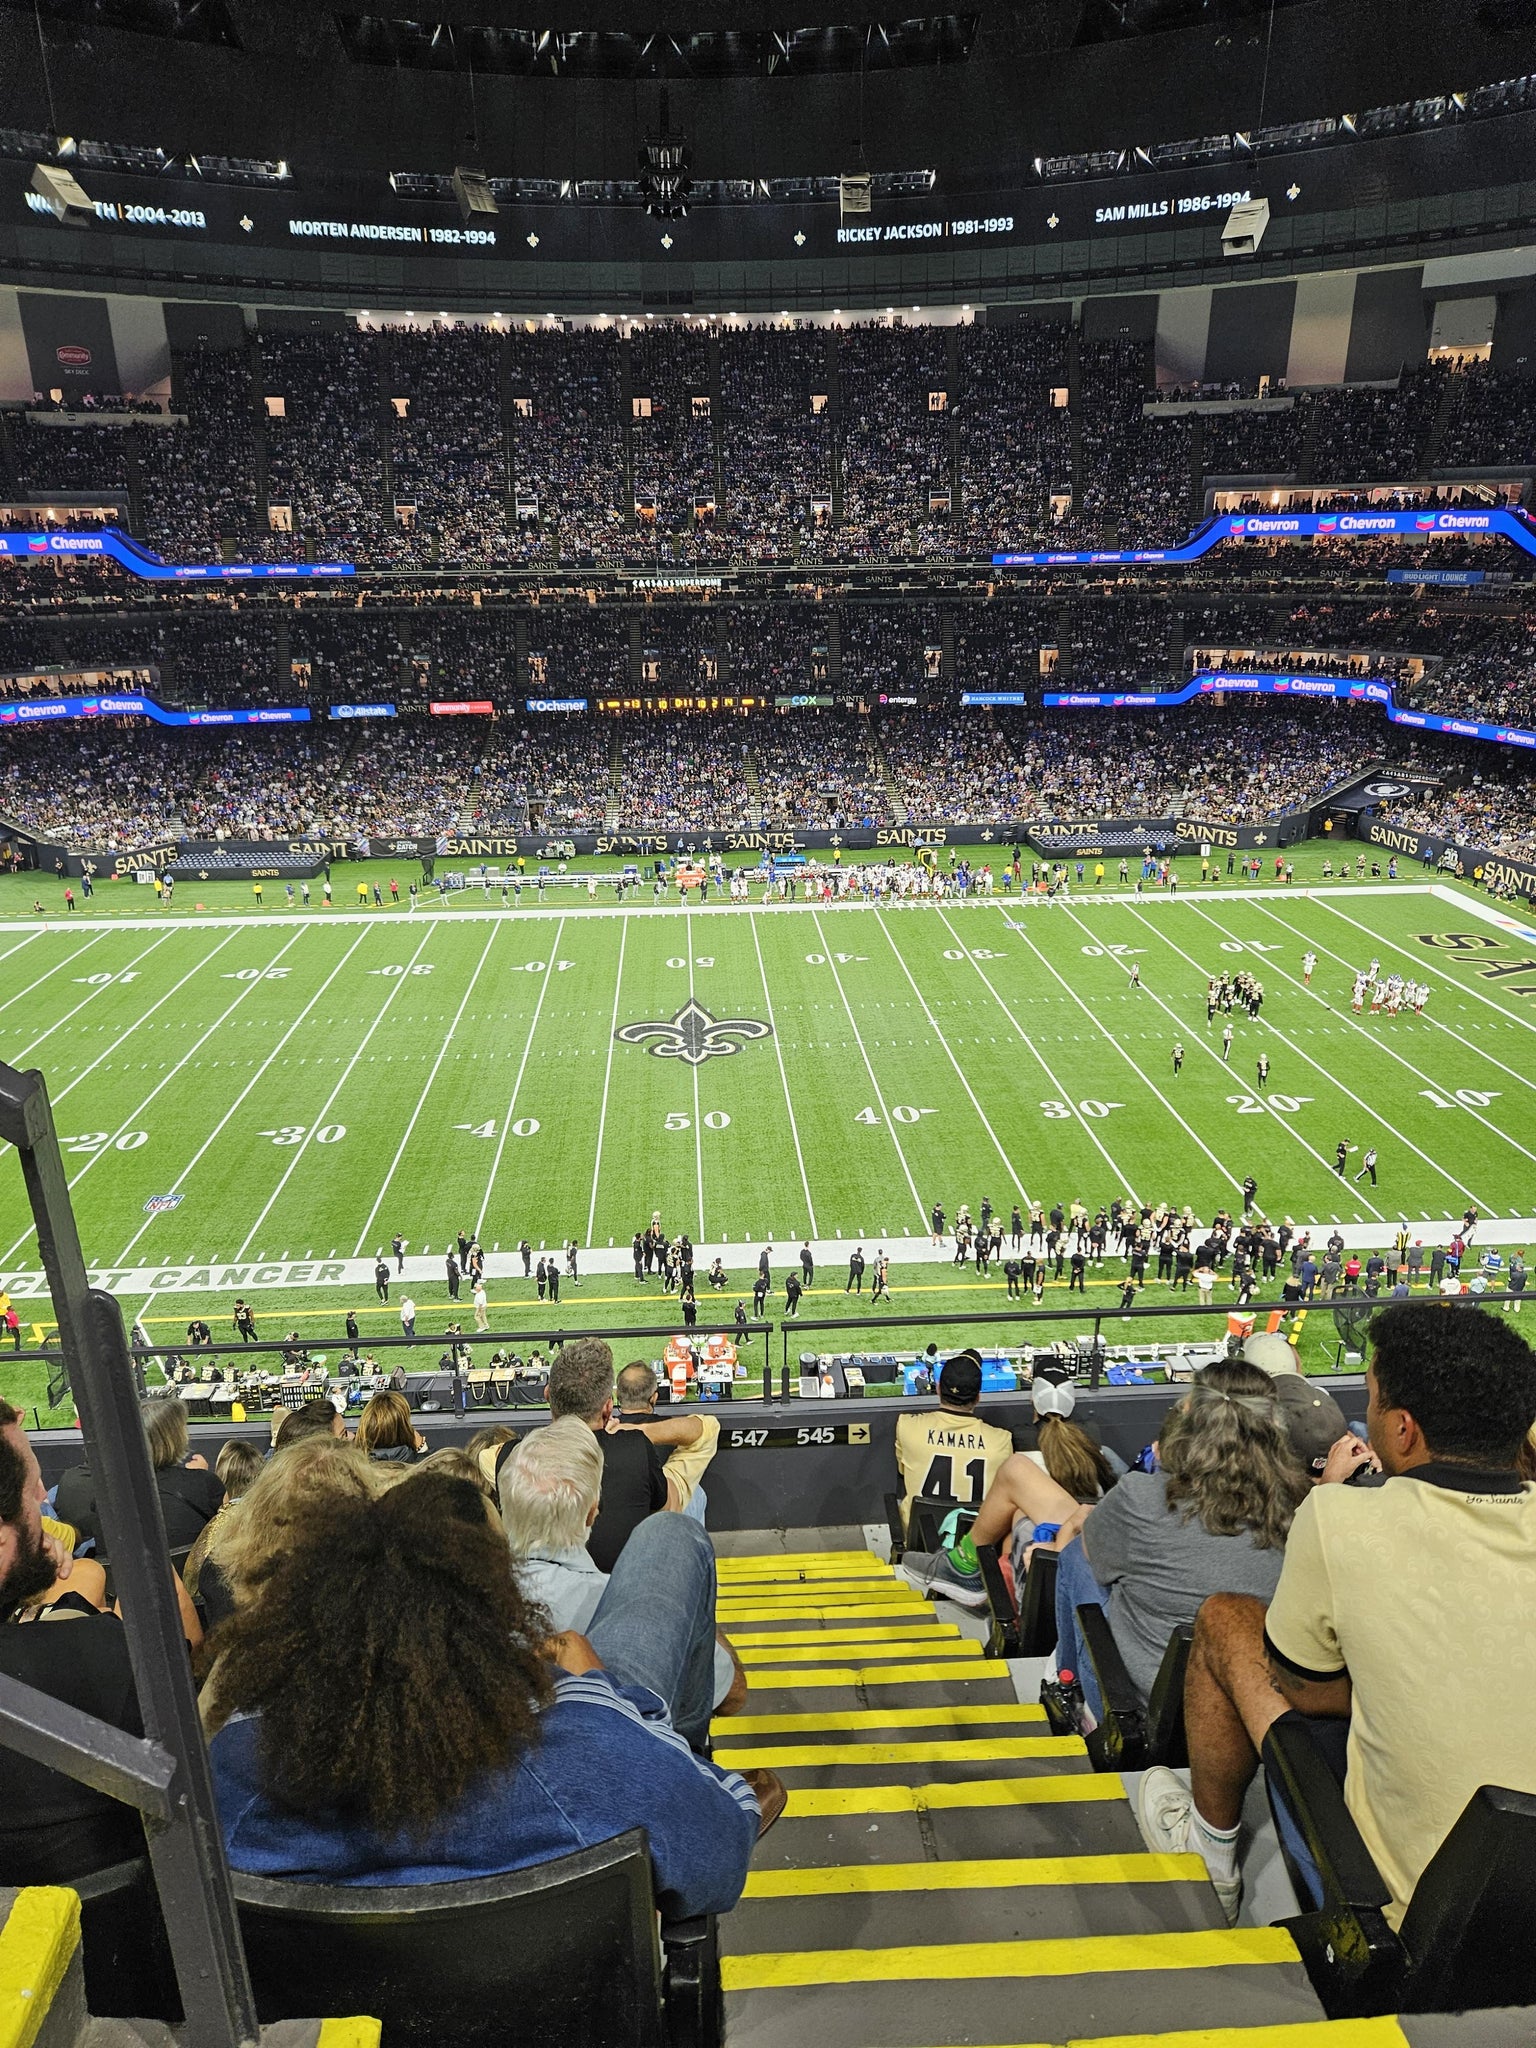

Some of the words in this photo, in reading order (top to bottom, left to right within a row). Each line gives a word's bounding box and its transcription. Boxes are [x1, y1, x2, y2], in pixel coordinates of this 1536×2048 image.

[1095, 205, 1125, 223] SAM
[1128, 201, 1168, 219] MILLS
[1177, 190, 1252, 213] 1986-1994
[124, 204, 207, 229] 2004-2013
[289, 220, 348, 238] MORTEN
[350, 223, 422, 242] ANDERSEN
[428, 228, 497, 246] 1982-1994
[837, 226, 882, 243] RICKEY
[883, 222, 943, 241] JACKSON
[951, 216, 1014, 236] 1981-1993
[1247, 518, 1299, 531] Chevron
[1340, 516, 1396, 530] Chevron
[1439, 514, 1490, 528] Chevron
[51, 537, 103, 550] Chevron
[528, 561, 558, 570] SAINTS
[595, 560, 625, 569] SAINTS
[728, 558, 758, 567] SAINTS
[793, 557, 823, 565] SAINTS
[859, 556, 889, 564] SAINTS
[925, 555, 955, 563] SAINTS
[391, 563, 422, 571] SAINTS
[461, 562, 491, 571] SAINTS
[675, 578, 722, 587] SUPERDOME
[1441, 573, 1467, 582] LOUNGE
[1215, 677, 1259, 690] Chevron
[1291, 680, 1335, 693] Chevron
[100, 699, 144, 711] Chevron
[537, 700, 585, 711] Ochsner
[791, 695, 817, 706] COX
[836, 695, 865, 703] SAINTS
[889, 696, 918, 705] entergy
[1070, 695, 1100, 704] Chevron
[1125, 695, 1156, 704] Chevron
[19, 704, 67, 717] Chevron
[260, 712, 292, 721] Chevron
[354, 707, 387, 717] Allstate
[201, 713, 234, 723] Chevron
[1401, 713, 1426, 725] Chevron
[1452, 722, 1478, 735] Chevron
[1507, 732, 1535, 745] Chevron
[1409, 773, 1440, 782] SUPERDOME
[725, 832, 795, 849] SAINTS
[876, 828, 947, 846] SAINTS
[1175, 822, 1238, 847] SAINTS
[1370, 825, 1419, 855] SAINTS
[447, 838, 518, 856] SAINTS
[1076, 848, 1103, 856] SAINTS
[115, 846, 178, 874] SAINTS
[252, 869, 279, 877] SAINTS
[1226, 1093, 1302, 1114] 20
[1419, 1088, 1491, 1108] 10
[854, 1105, 922, 1126] 40
[1040, 1100, 1111, 1120] 30
[664, 1110, 732, 1131] 50
[470, 1117, 541, 1138] 40
[272, 1124, 347, 1146] 30
[68, 1131, 149, 1153] 20
[151, 1263, 347, 1290] CANCER
[730, 1430, 768, 1448] 547
[797, 1426, 835, 1445] 545
[928, 1429, 986, 1450] KAMARA
[921, 1454, 986, 1502] 41
